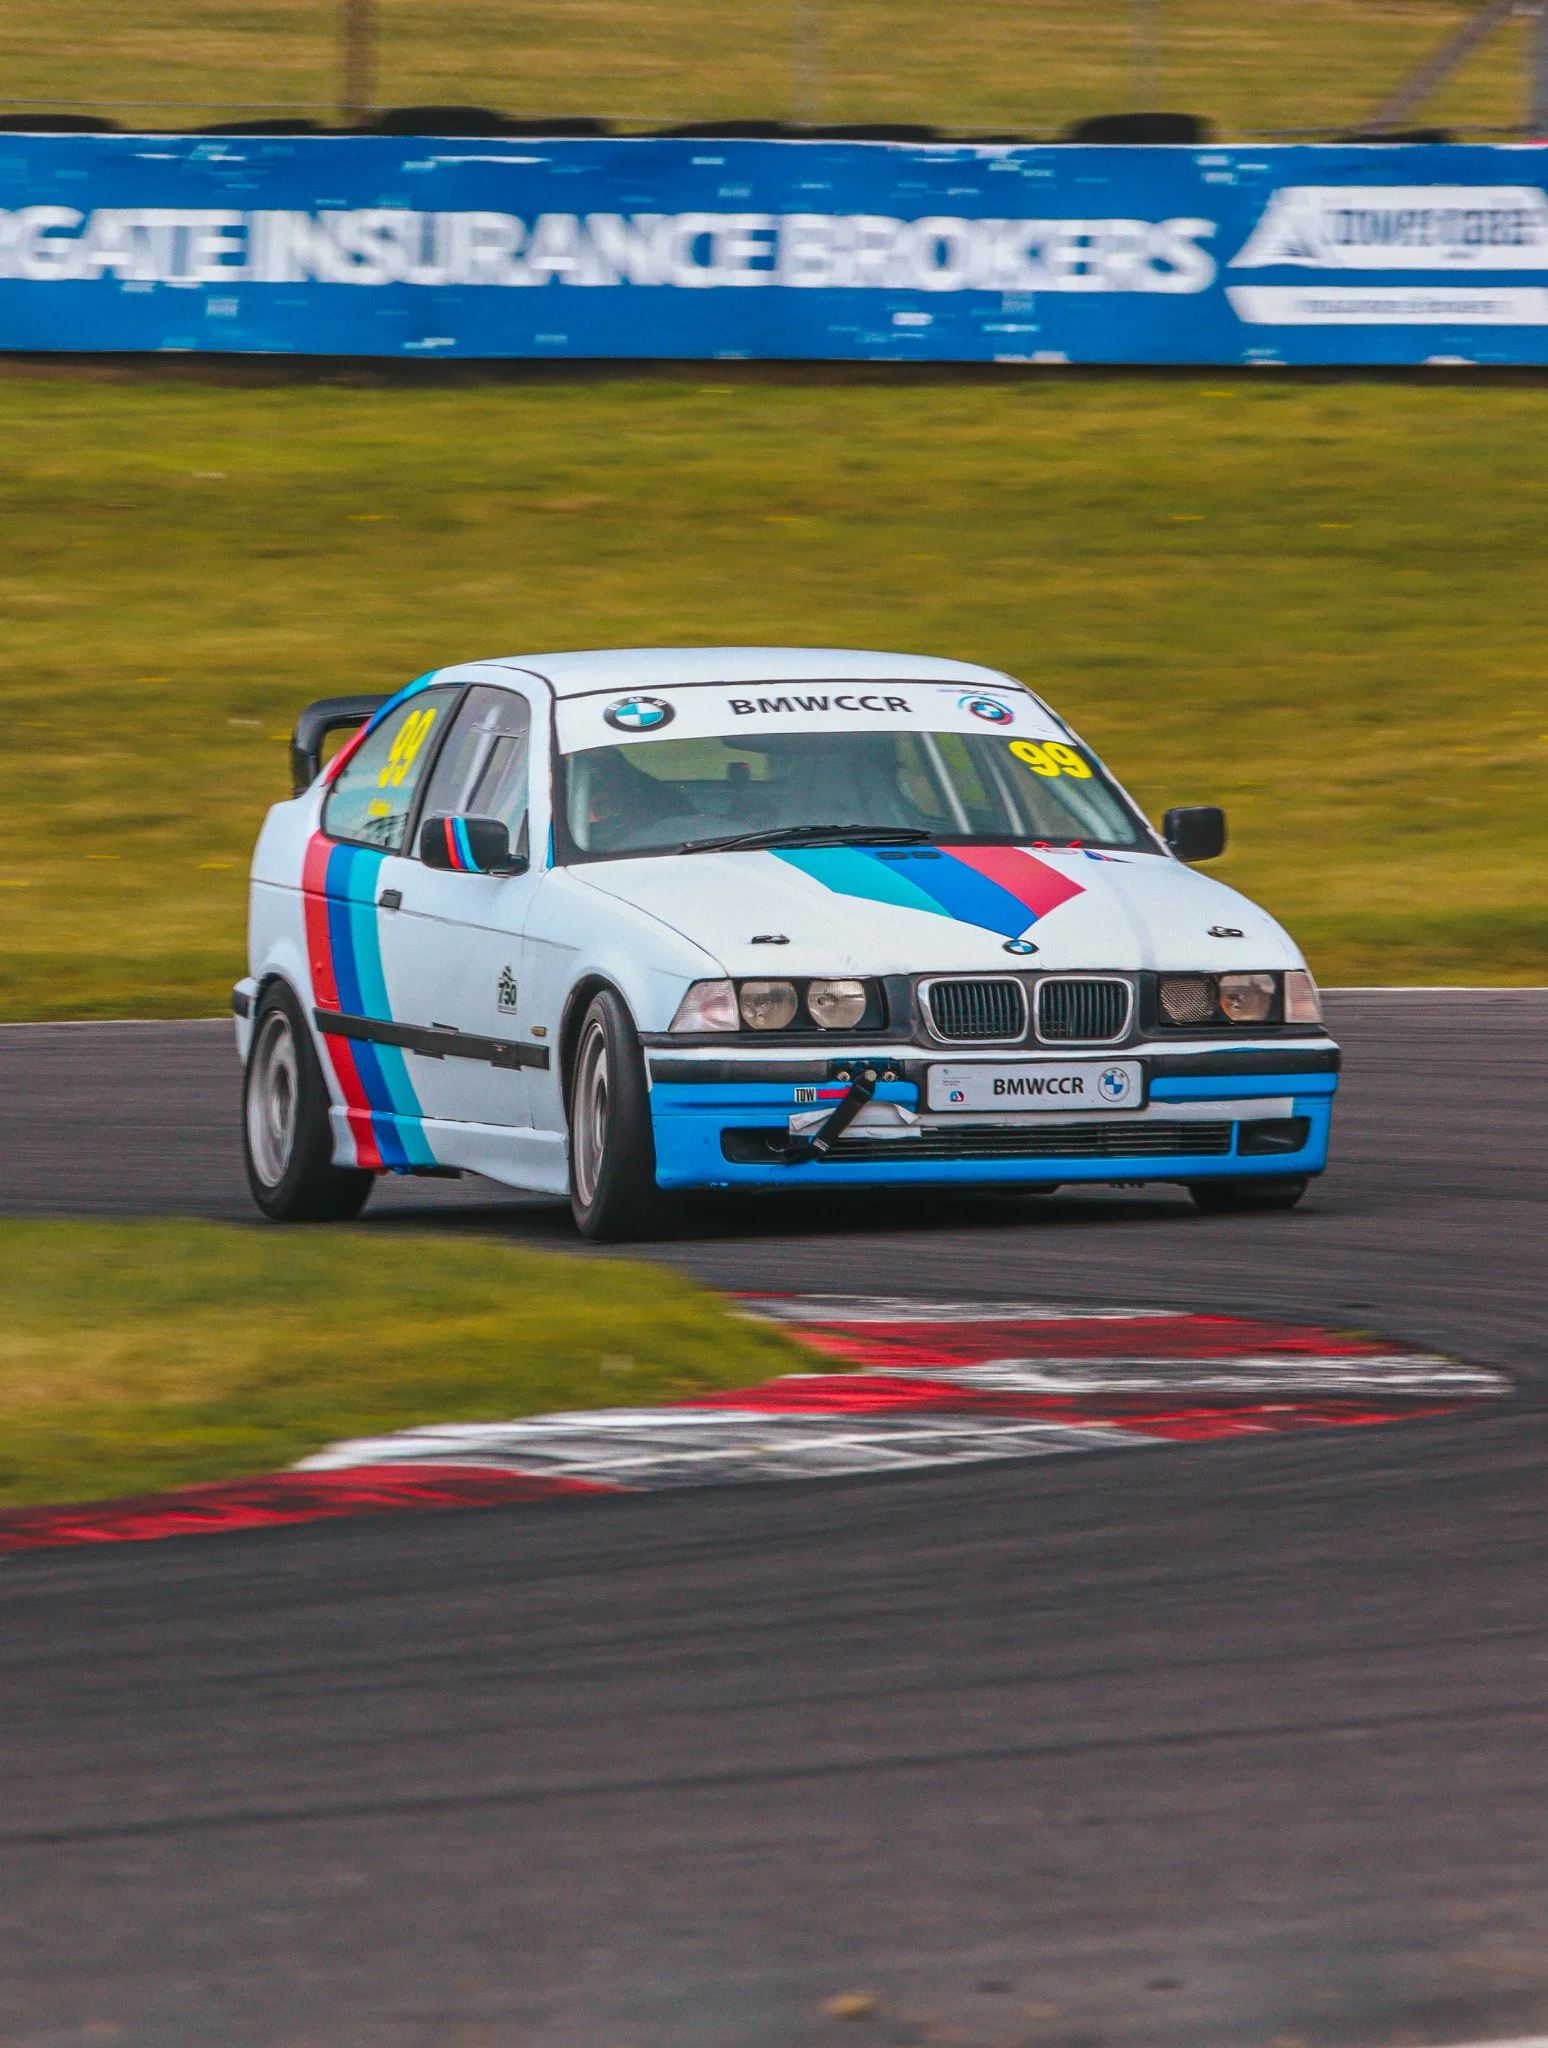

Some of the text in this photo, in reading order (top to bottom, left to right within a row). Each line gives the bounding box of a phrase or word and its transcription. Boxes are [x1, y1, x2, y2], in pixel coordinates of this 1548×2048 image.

[248, 208, 777, 288] INSURANCE
[777, 212, 1217, 293] BROKERS
[728, 696, 913, 715] BMWCCR
[377, 708, 437, 788] 99
[1009, 740, 1092, 779] 99
[796, 1088, 814, 1102] TOW
[993, 1077, 1084, 1095] BMWCCR
